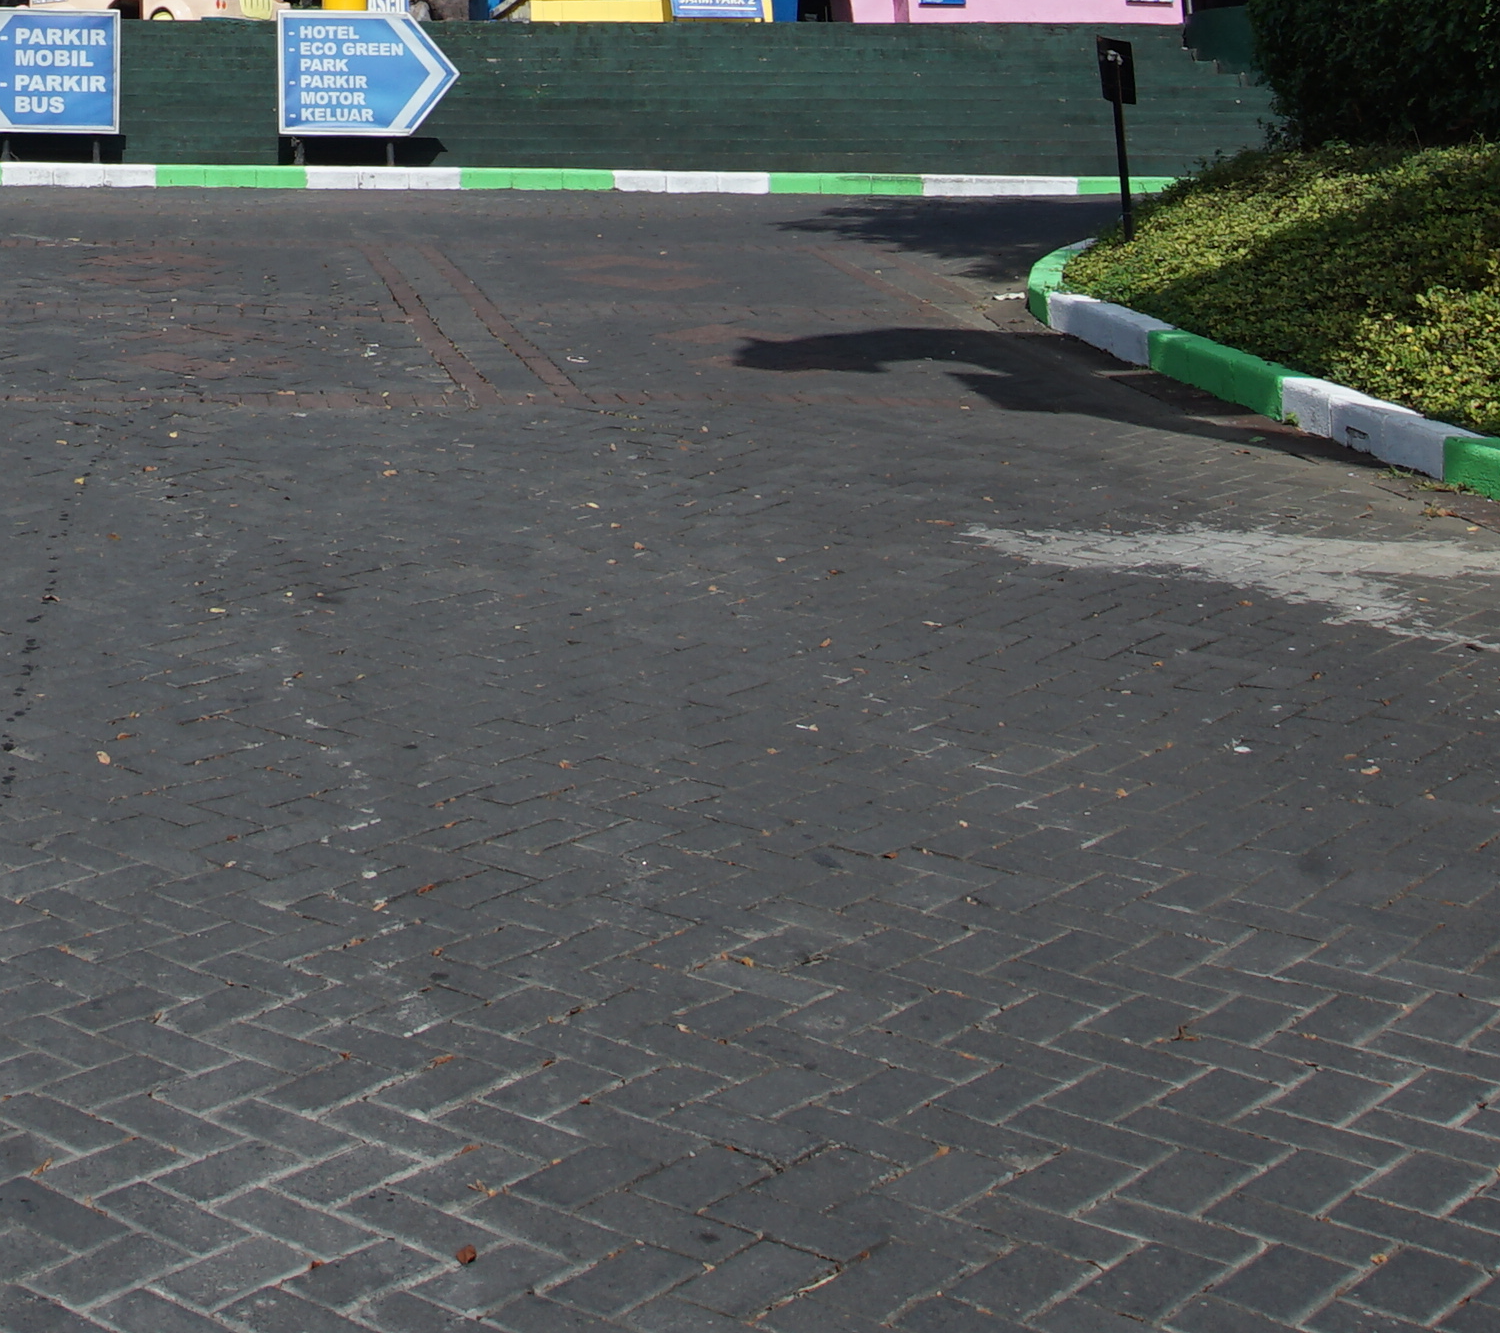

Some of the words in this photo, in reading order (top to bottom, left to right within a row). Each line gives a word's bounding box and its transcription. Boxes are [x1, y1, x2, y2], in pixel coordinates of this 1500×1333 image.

[15, 28, 107, 46] PARKIR
[300, 26, 360, 39] HOTEL
[300, 42, 337, 56] ECO
[342, 43, 404, 56] GREEN
[15, 50, 94, 67] MOBIL
[300, 59, 349, 72] PARK
[14, 75, 106, 92] PARKIR
[300, 75, 368, 89] PARKIR
[15, 96, 65, 114] BUS
[301, 92, 366, 105] MOTOR
[301, 108, 374, 122] KELUAR
